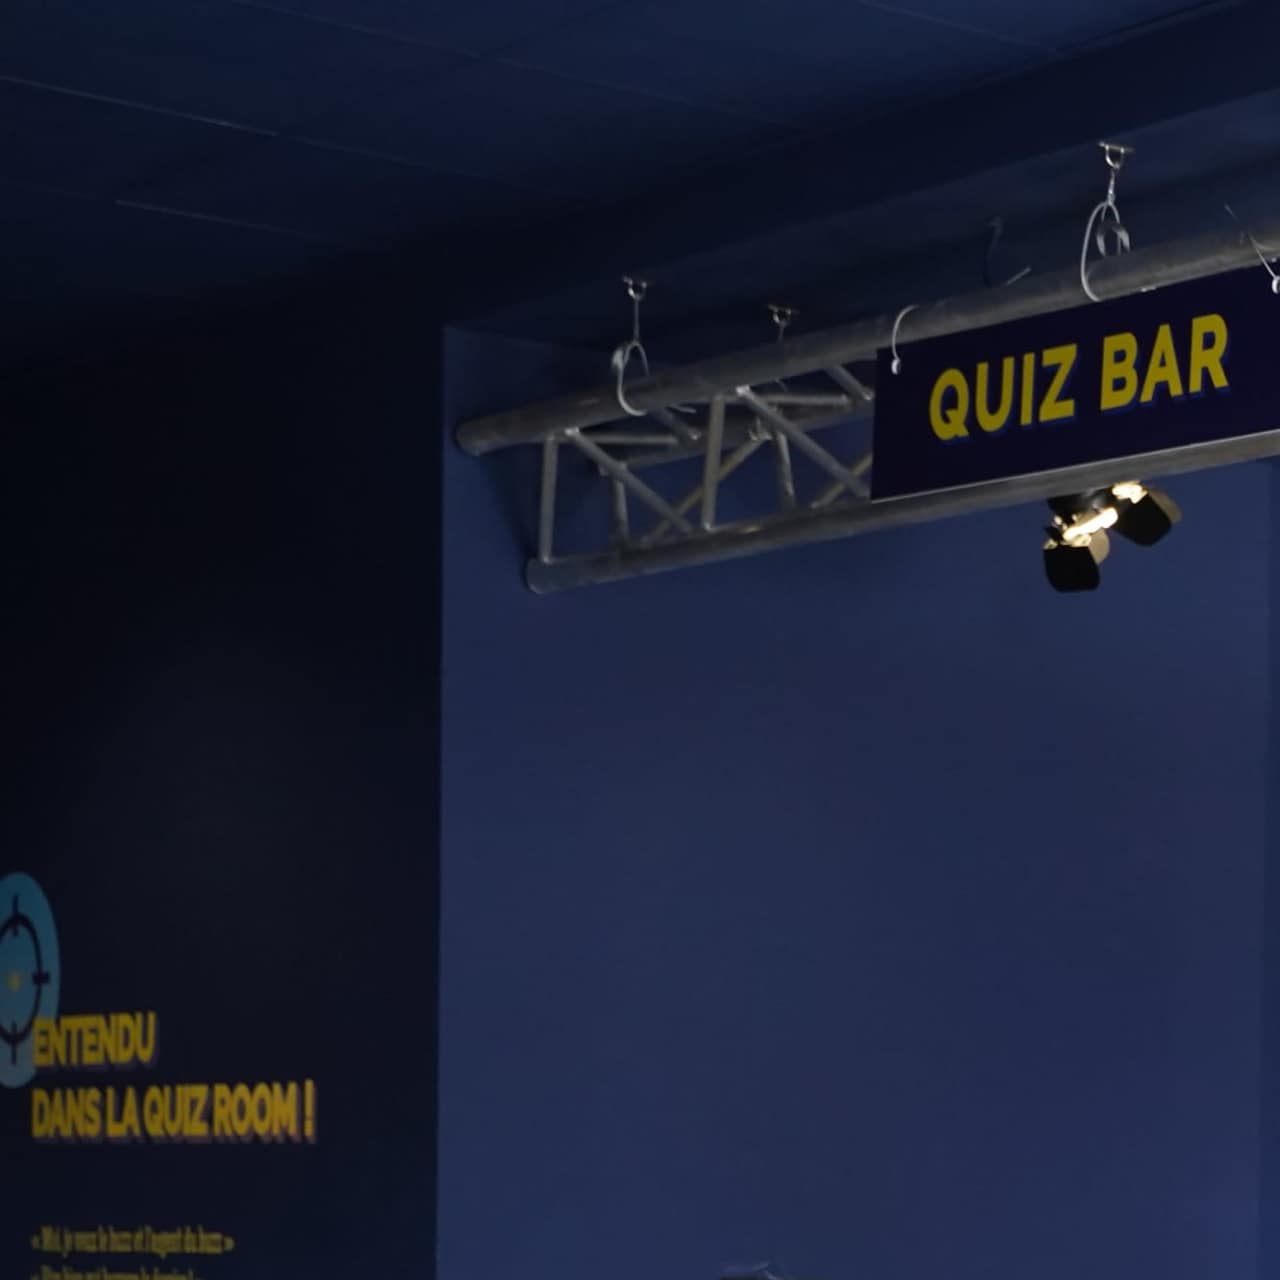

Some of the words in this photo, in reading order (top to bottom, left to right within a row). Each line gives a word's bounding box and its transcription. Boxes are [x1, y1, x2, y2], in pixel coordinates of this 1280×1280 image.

[929, 343, 1078, 443] QUIZ
[1100, 313, 1230, 411] BAR
[31, 1010, 157, 1067] ENTENDU
[31, 1085, 102, 1139] DANS
[106, 1085, 141, 1138] LA
[143, 1082, 210, 1138] QUIZ
[211, 1080, 299, 1137] ROOM
